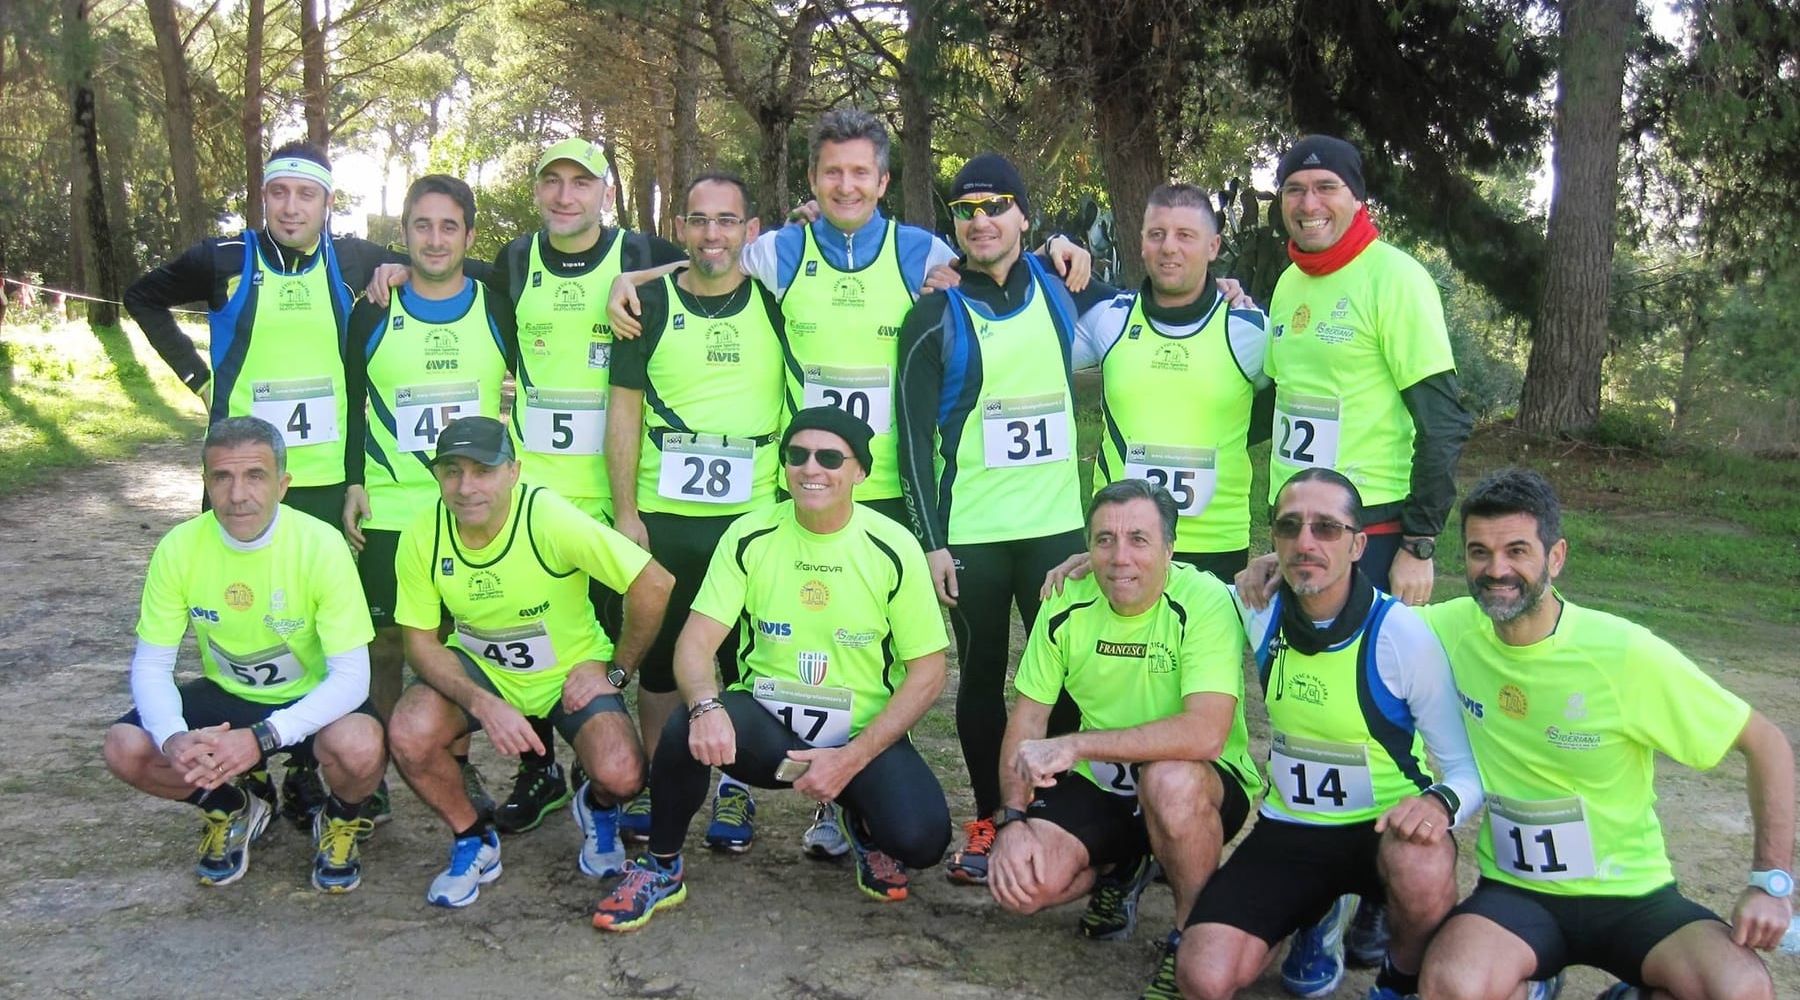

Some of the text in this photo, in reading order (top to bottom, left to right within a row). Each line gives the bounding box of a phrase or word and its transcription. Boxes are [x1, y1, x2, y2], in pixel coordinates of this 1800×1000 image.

[592, 323, 611, 334] AV
[877, 325, 901, 337] AVI
[426, 359, 459, 370] AVIS
[706, 350, 741, 363] AVIS
[287, 402, 312, 440] 4
[552, 413, 574, 449] 5
[1007, 418, 1053, 461] 31
[1279, 416, 1315, 463] 22
[681, 456, 732, 498] 28
[802, 564, 843, 573] GIVOVA
[519, 600, 550, 617] AVIS
[483, 642, 534, 669] 43
[800, 651, 828, 661] Italia
[229, 663, 287, 686] 52
[777, 706, 829, 742] 17
[1105, 761, 1140, 791] 2
[1290, 763, 1348, 807] 14
[1509, 826, 1568, 873] 11
